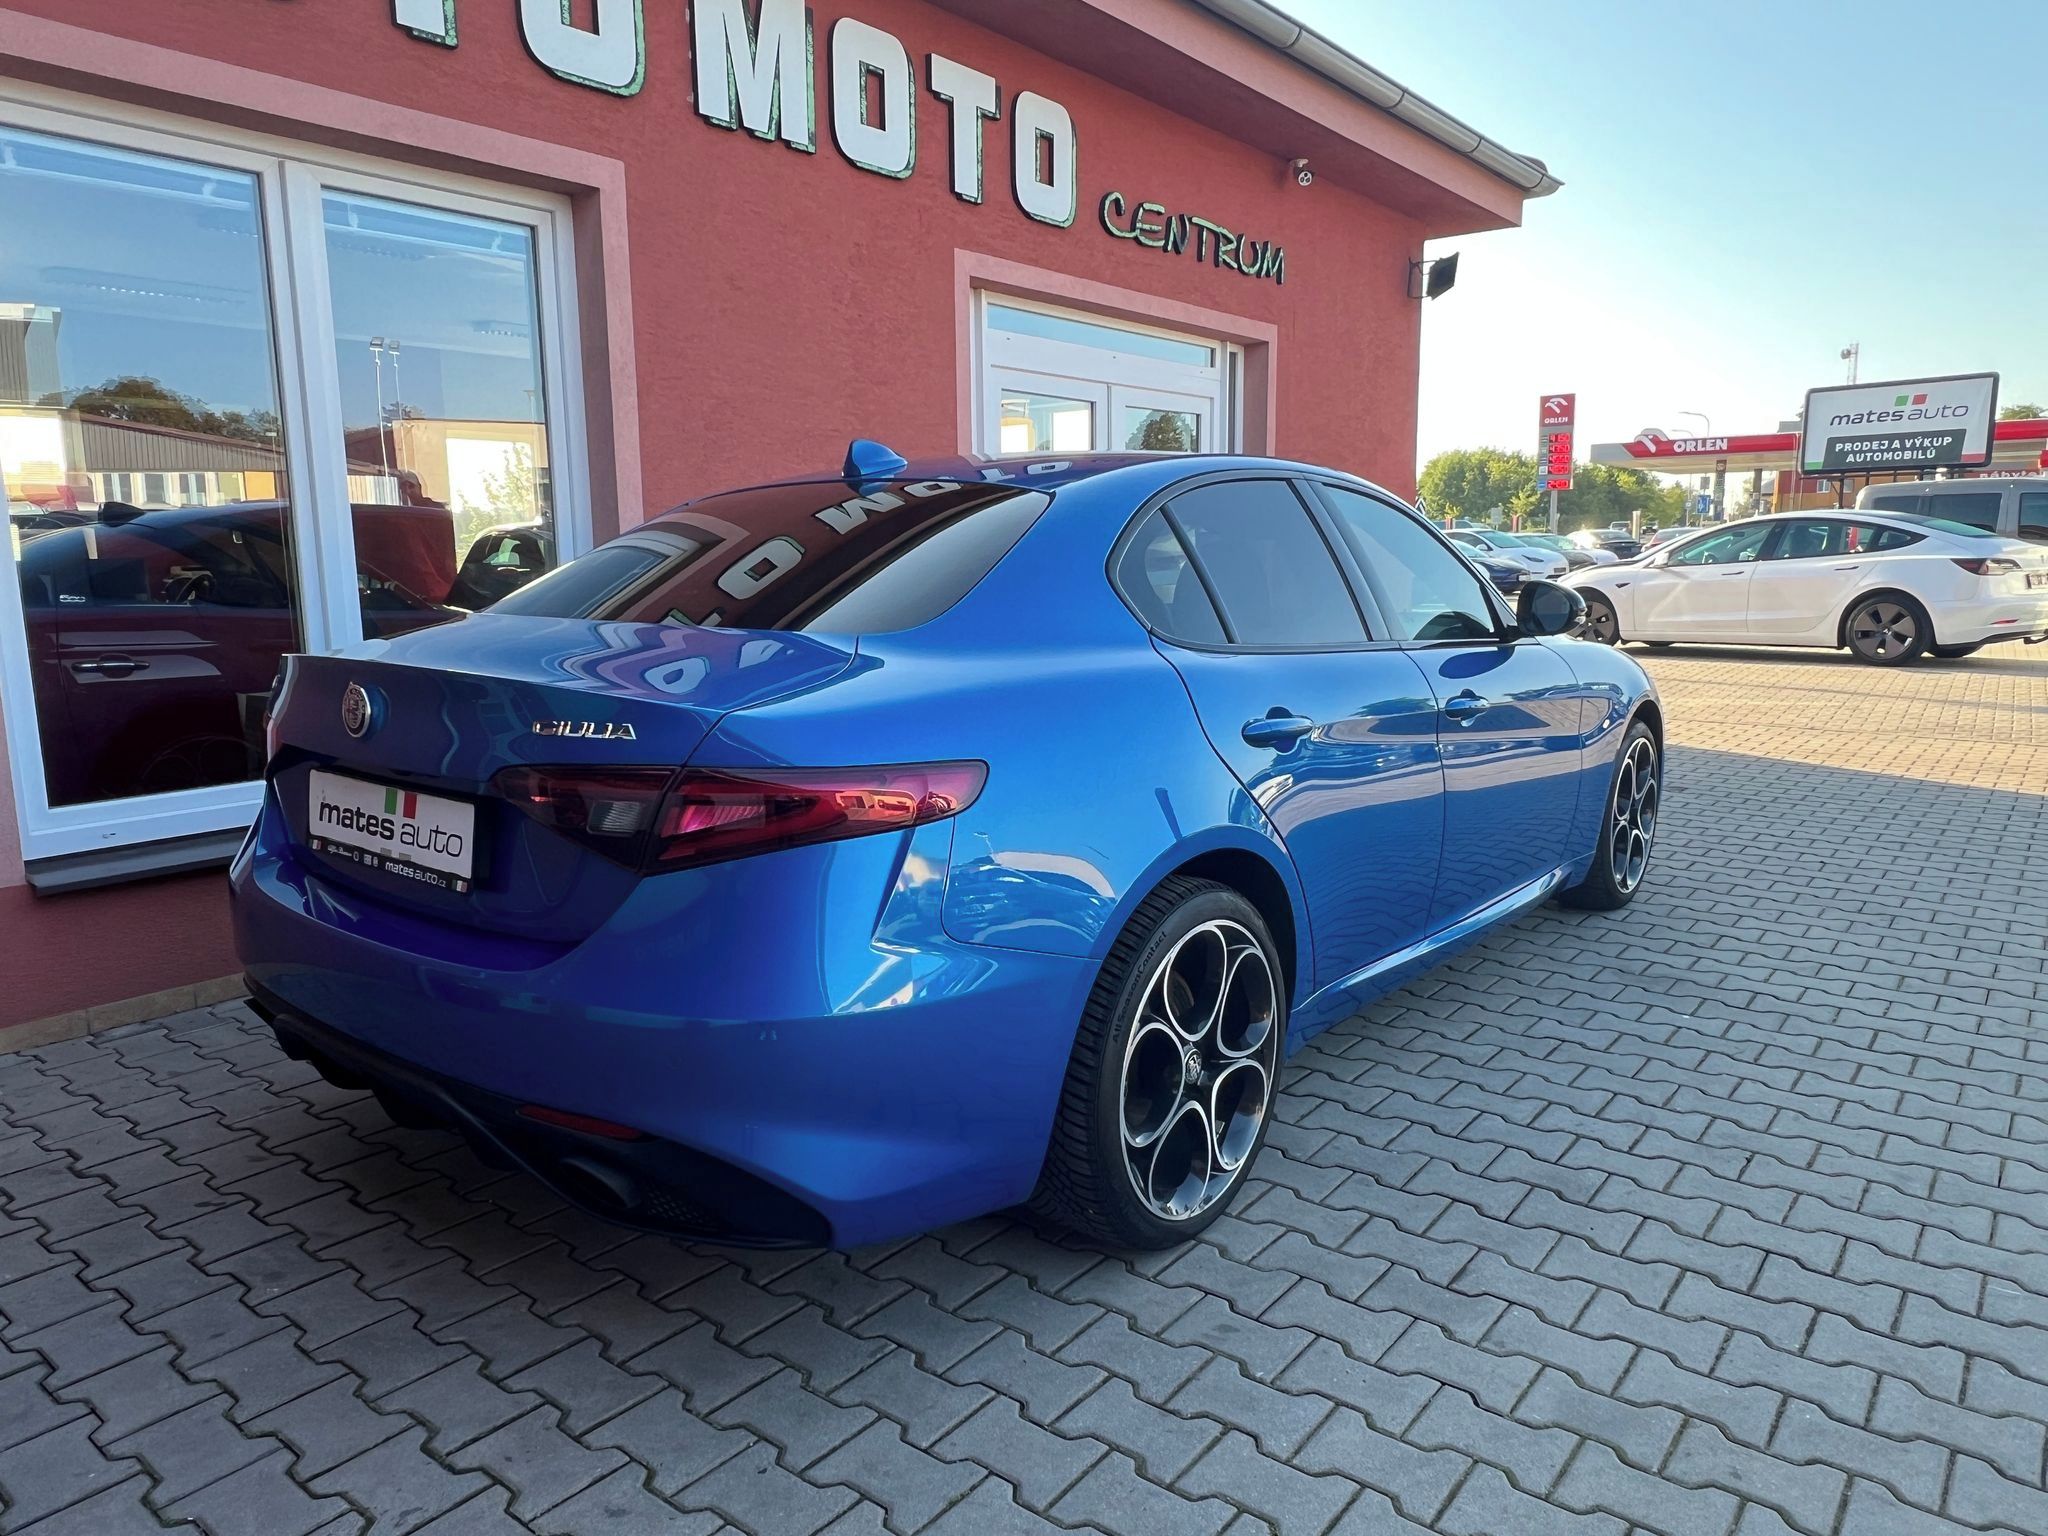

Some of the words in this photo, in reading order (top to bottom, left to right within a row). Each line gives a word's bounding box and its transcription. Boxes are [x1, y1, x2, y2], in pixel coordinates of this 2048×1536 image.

[690, 0, 1078, 229] MOTO
[1099, 190, 1285, 285] CENTRUM
[1544, 416, 1568, 424] ORLEN
[1673, 438, 1728, 453] ORLEN
[1835, 440, 1889, 452] PRODEJ
[1890, 439, 1901, 449] A
[1904, 436, 1953, 448] VÝKUP
[532, 720, 637, 740] GIULIA
